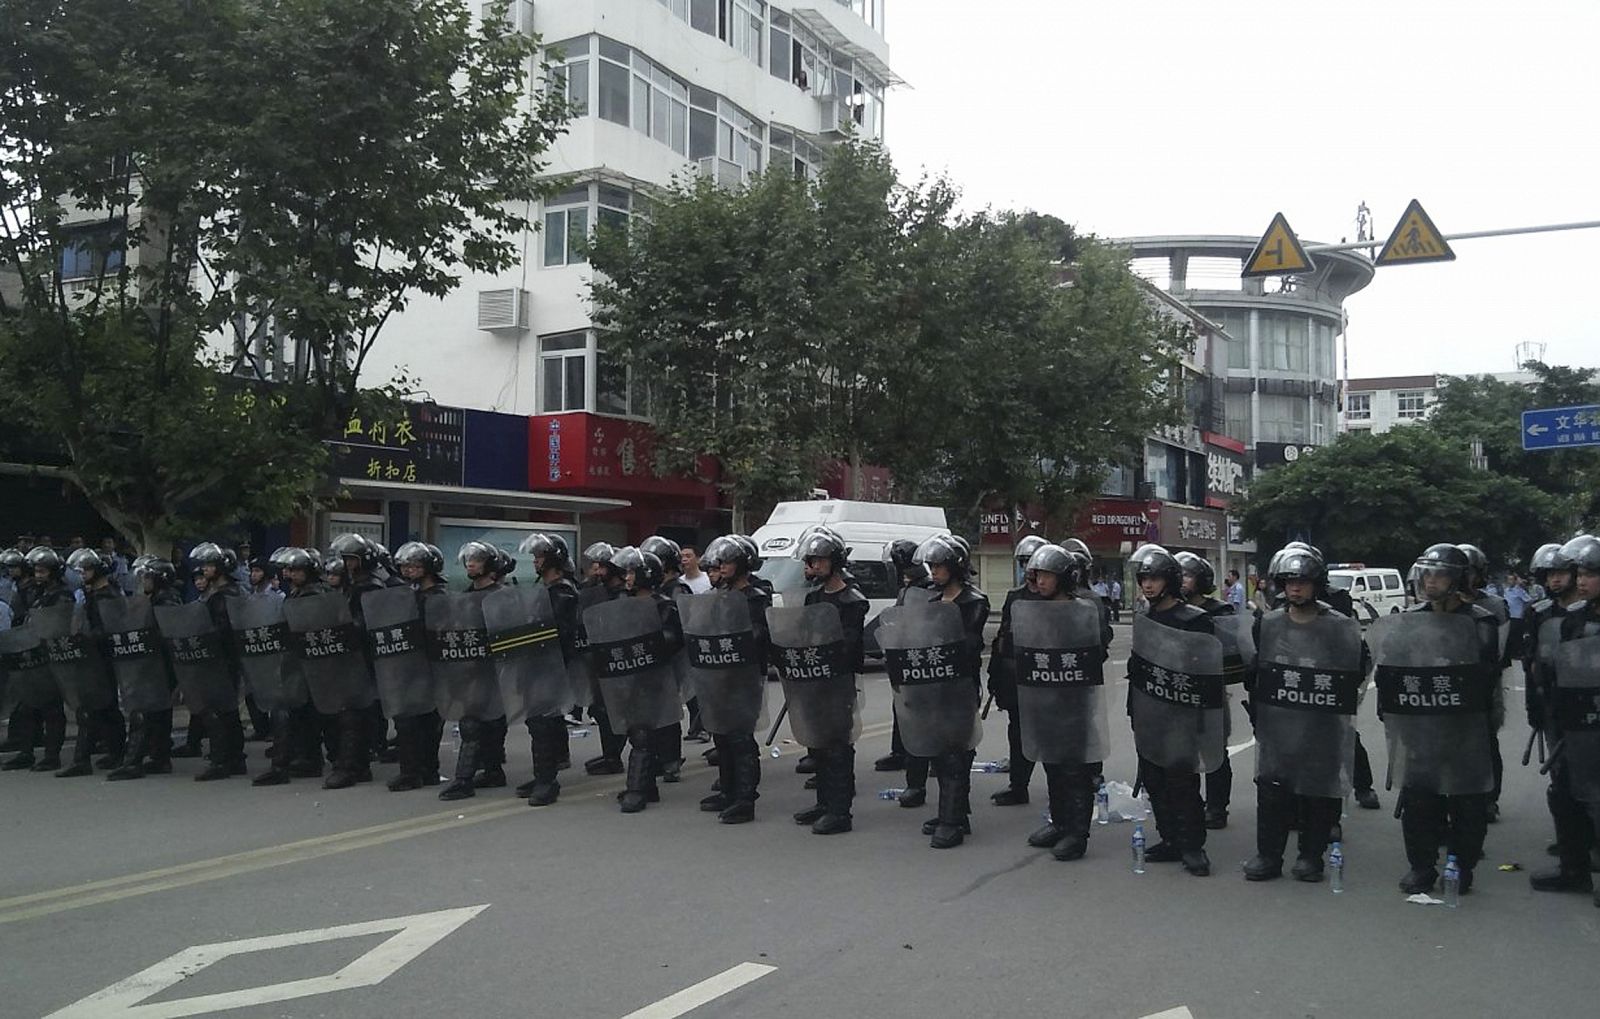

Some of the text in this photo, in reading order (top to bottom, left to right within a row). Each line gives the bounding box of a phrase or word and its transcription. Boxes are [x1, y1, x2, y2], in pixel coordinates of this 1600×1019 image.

[367, 457, 416, 482] 折扣店
[245, 640, 280, 654] POLICE
[444, 630, 479, 648] 警察
[697, 637, 733, 653] 警察
[114, 642, 145, 657] POLICE
[305, 642, 344, 657] POLICE
[375, 641, 409, 655] POLICE
[442, 646, 485, 659] POLICE
[608, 654, 654, 672] POLICE
[697, 652, 740, 665] POLICE
[784, 647, 822, 666] 警察
[907, 646, 947, 667] 警察
[1034, 652, 1079, 669] 警察
[786, 664, 831, 679] POLICE
[903, 664, 954, 680] POLICE
[1032, 669, 1084, 683] POLICE
[1151, 665, 1193, 691] 警察
[1282, 669, 1333, 691] 警察
[1403, 674, 1452, 693] 警察
[1145, 680, 1201, 705] POLICE
[1277, 688, 1337, 706] POLICE
[1398, 692, 1462, 707] POLICE
